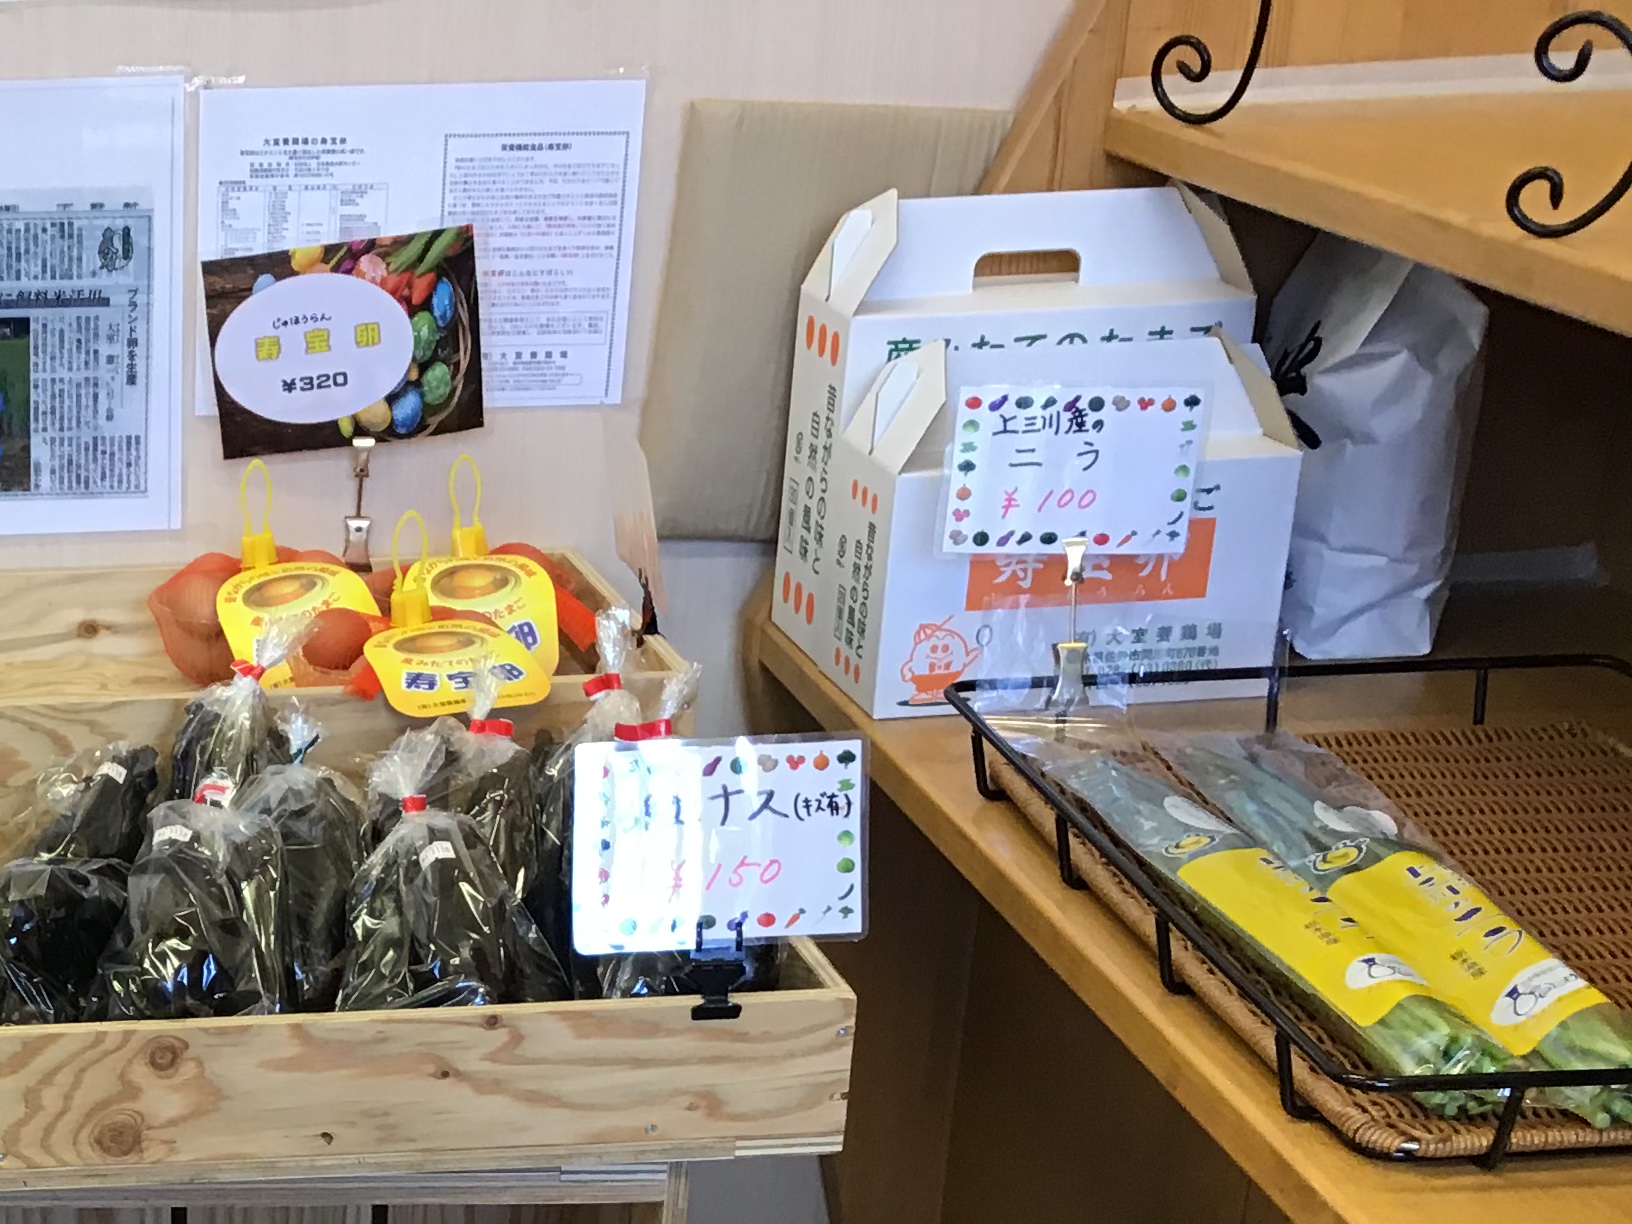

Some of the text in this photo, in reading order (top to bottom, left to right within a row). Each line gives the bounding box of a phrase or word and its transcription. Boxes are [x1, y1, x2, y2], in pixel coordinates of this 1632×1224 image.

[272, 313, 332, 330] じゅほうらん
[255, 321, 381, 361] 寿宝卵
[281, 371, 348, 393] ¥320
[992, 407, 1105, 436] 上三川産の
[1001, 486, 1098, 520] ¥100
